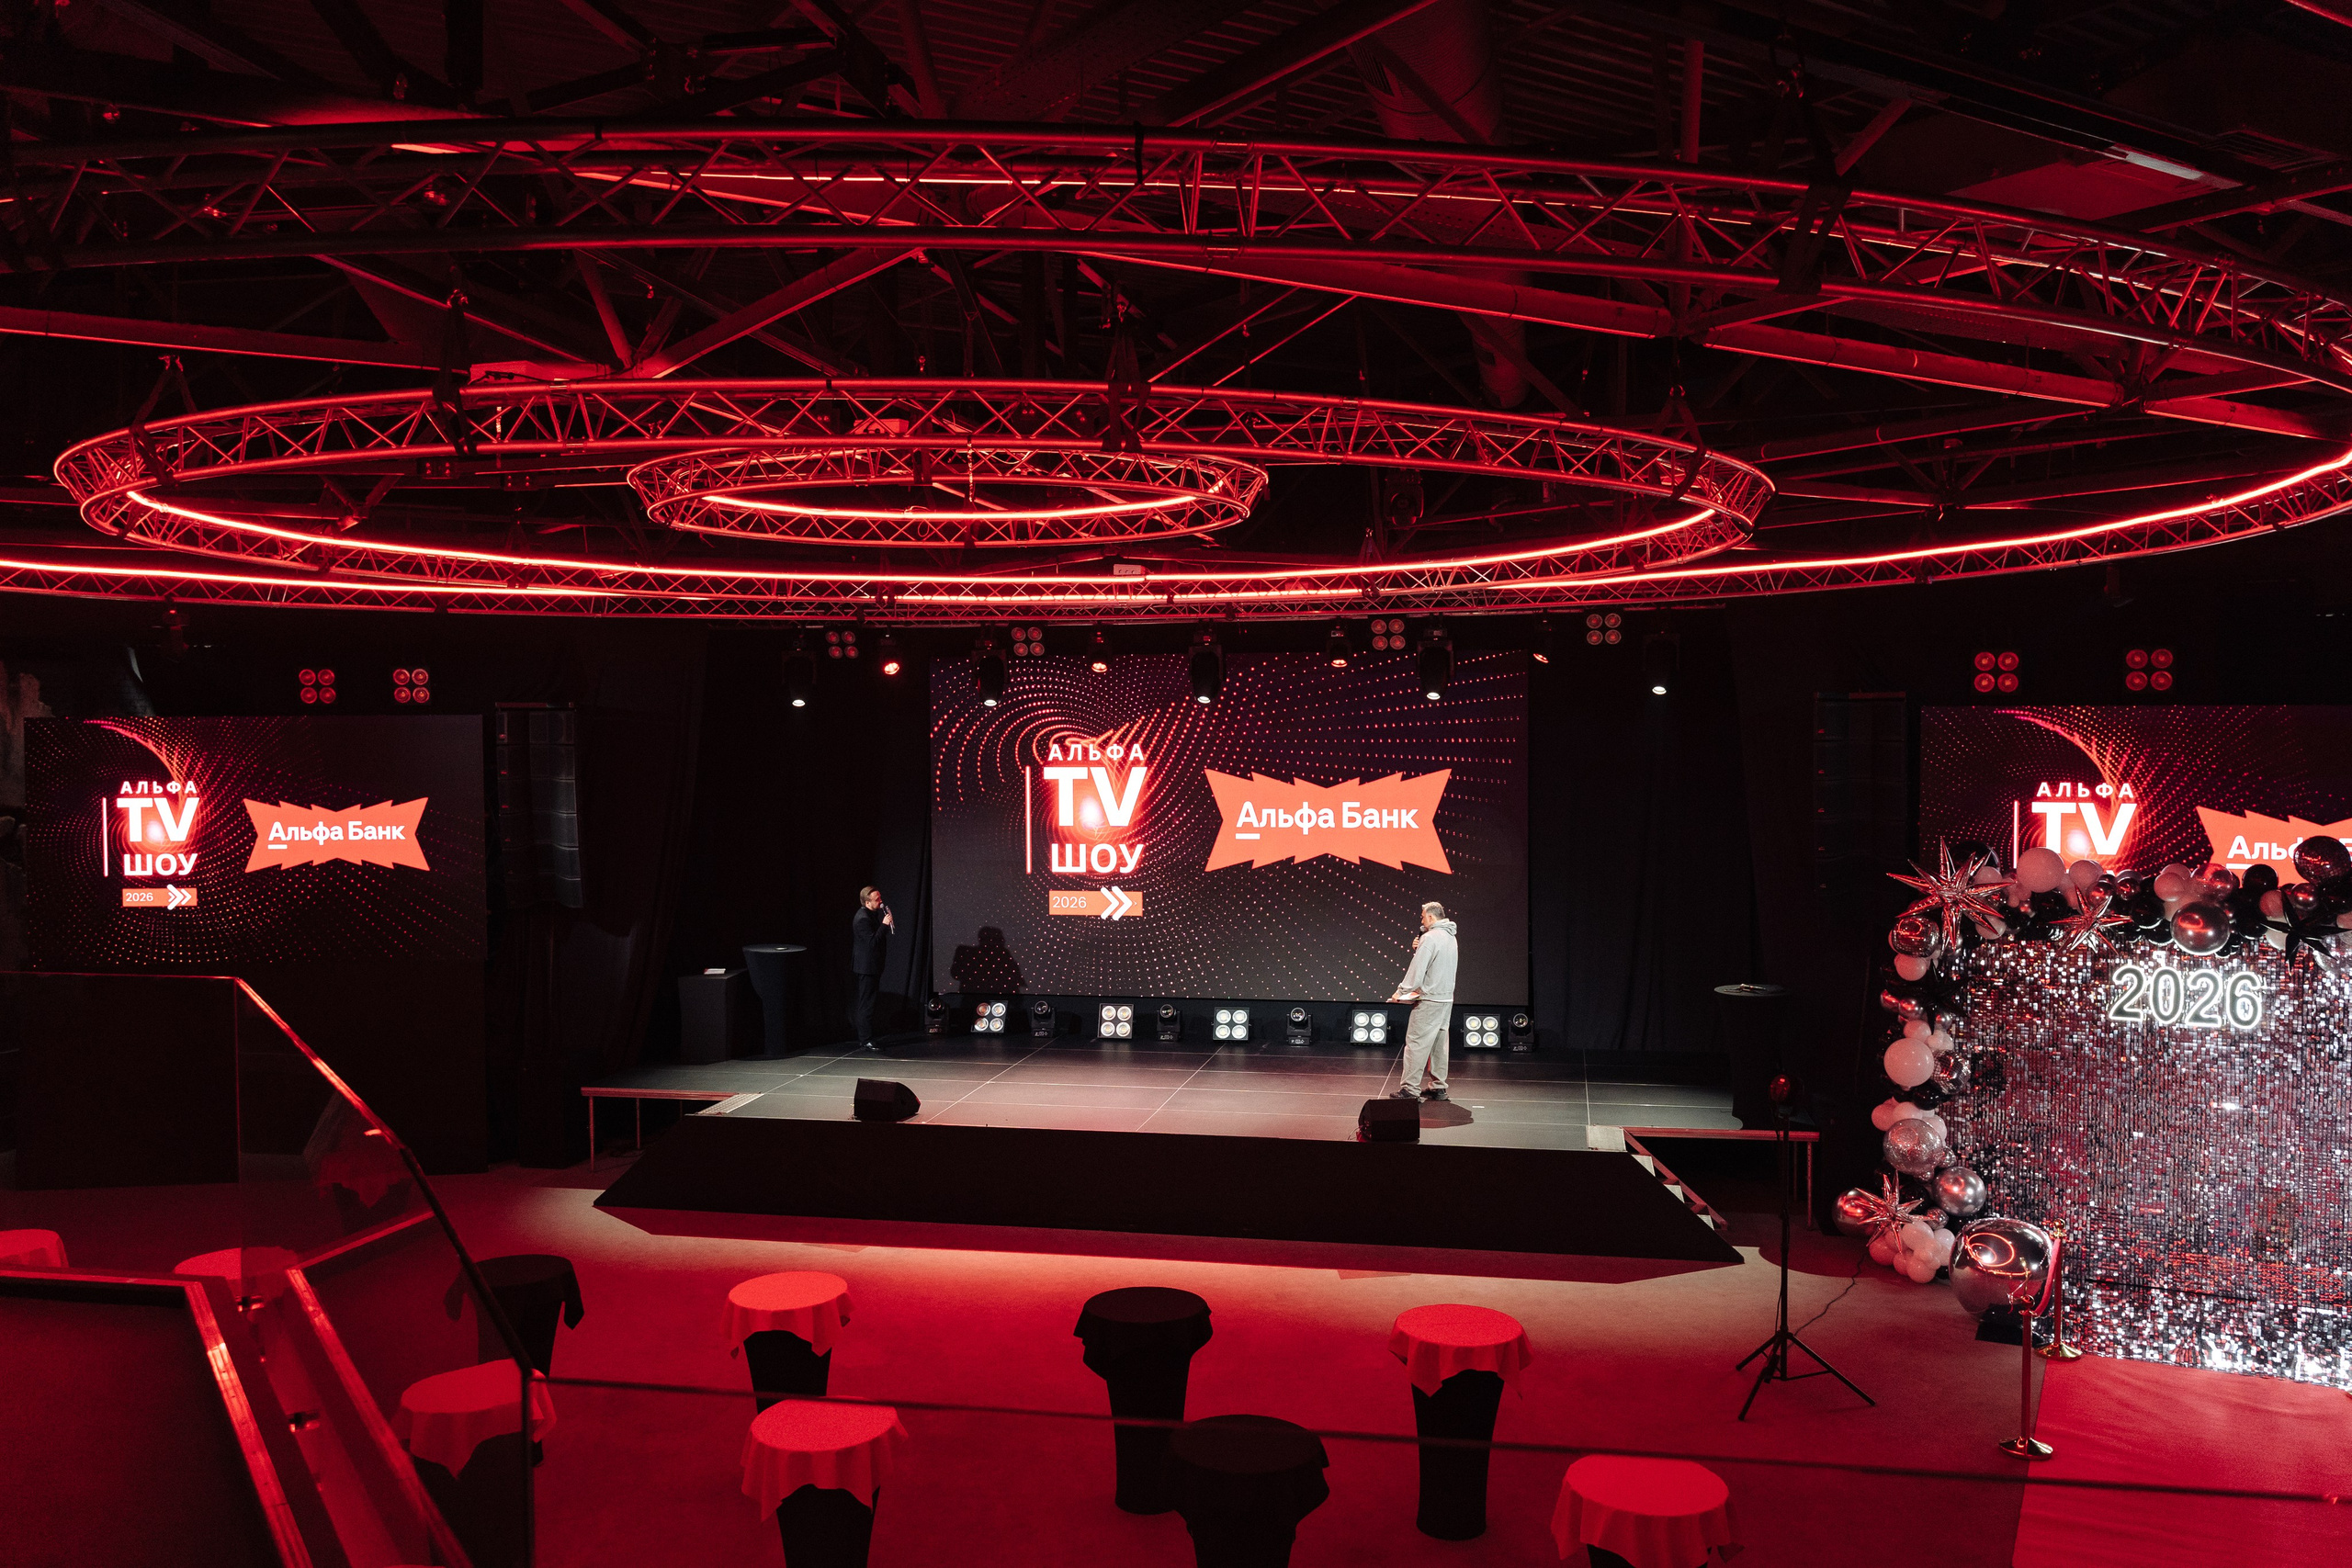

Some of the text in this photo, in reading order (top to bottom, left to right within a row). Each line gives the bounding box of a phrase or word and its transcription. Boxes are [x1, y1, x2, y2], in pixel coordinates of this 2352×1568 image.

[1047, 743, 1145, 761] АЛЬФА
[119, 781, 198, 795] АЛЬФА
[1043, 766, 1148, 827] TV
[2036, 782, 2134, 798] АЛЬФА
[117, 796, 199, 842] TV
[1236, 800, 1419, 836] Альфа Банк
[2031, 801, 2138, 855] TV
[267, 820, 406, 846] Альфа Банк
[123, 852, 198, 876] ШОУ
[1051, 843, 1145, 874] ШОУ
[125, 892, 154, 903] 2026
[1052, 896, 1088, 909] 2026
[2109, 964, 2262, 1030] 2026
